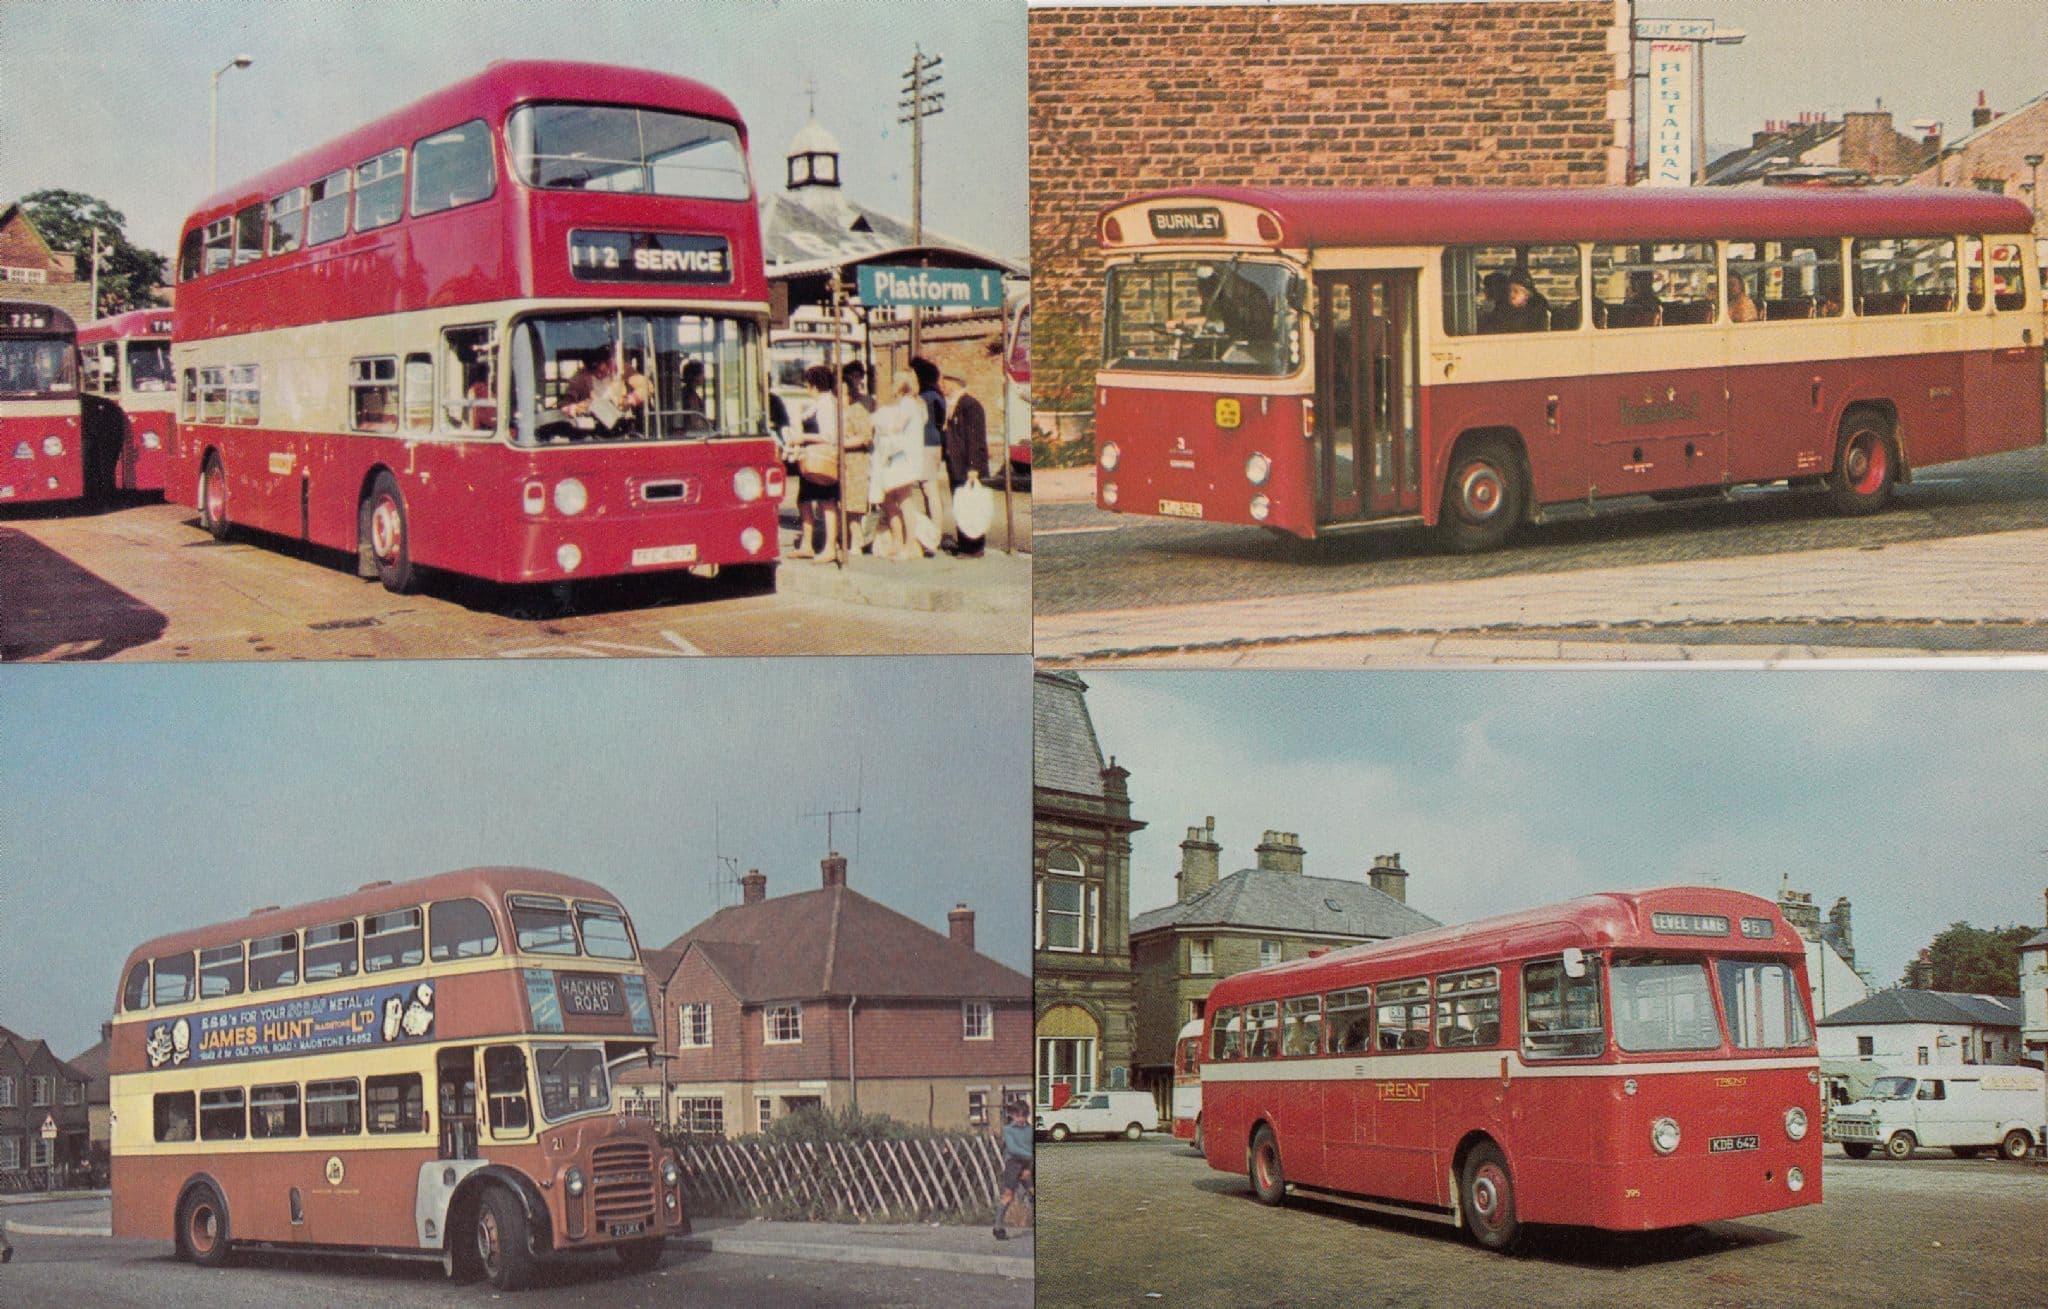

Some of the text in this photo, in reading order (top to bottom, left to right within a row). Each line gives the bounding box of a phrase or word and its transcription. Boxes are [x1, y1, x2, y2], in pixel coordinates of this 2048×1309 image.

[1156, 213, 1220, 230] BURNLEY
[571, 245, 723, 273] 112 SERVICE
[874, 270, 991, 301] Platform 1
[1651, 916, 1689, 931] LEVEL
[561, 980, 616, 997] HACKNEY
[240, 1010, 258, 1025] FOR
[260, 1006, 286, 1021] YOUR
[329, 995, 362, 1013] METAL
[574, 995, 610, 1011] ROAD
[199, 1024, 258, 1051] JAMES
[263, 1017, 315, 1042] HUNT
[235, 1046, 249, 1057] OLD
[272, 1041, 293, 1054] ROAD
[1375, 1081, 1430, 1102] TRENT
[552, 1137, 564, 1151] 21
[1712, 1136, 1757, 1152] KDB 642
